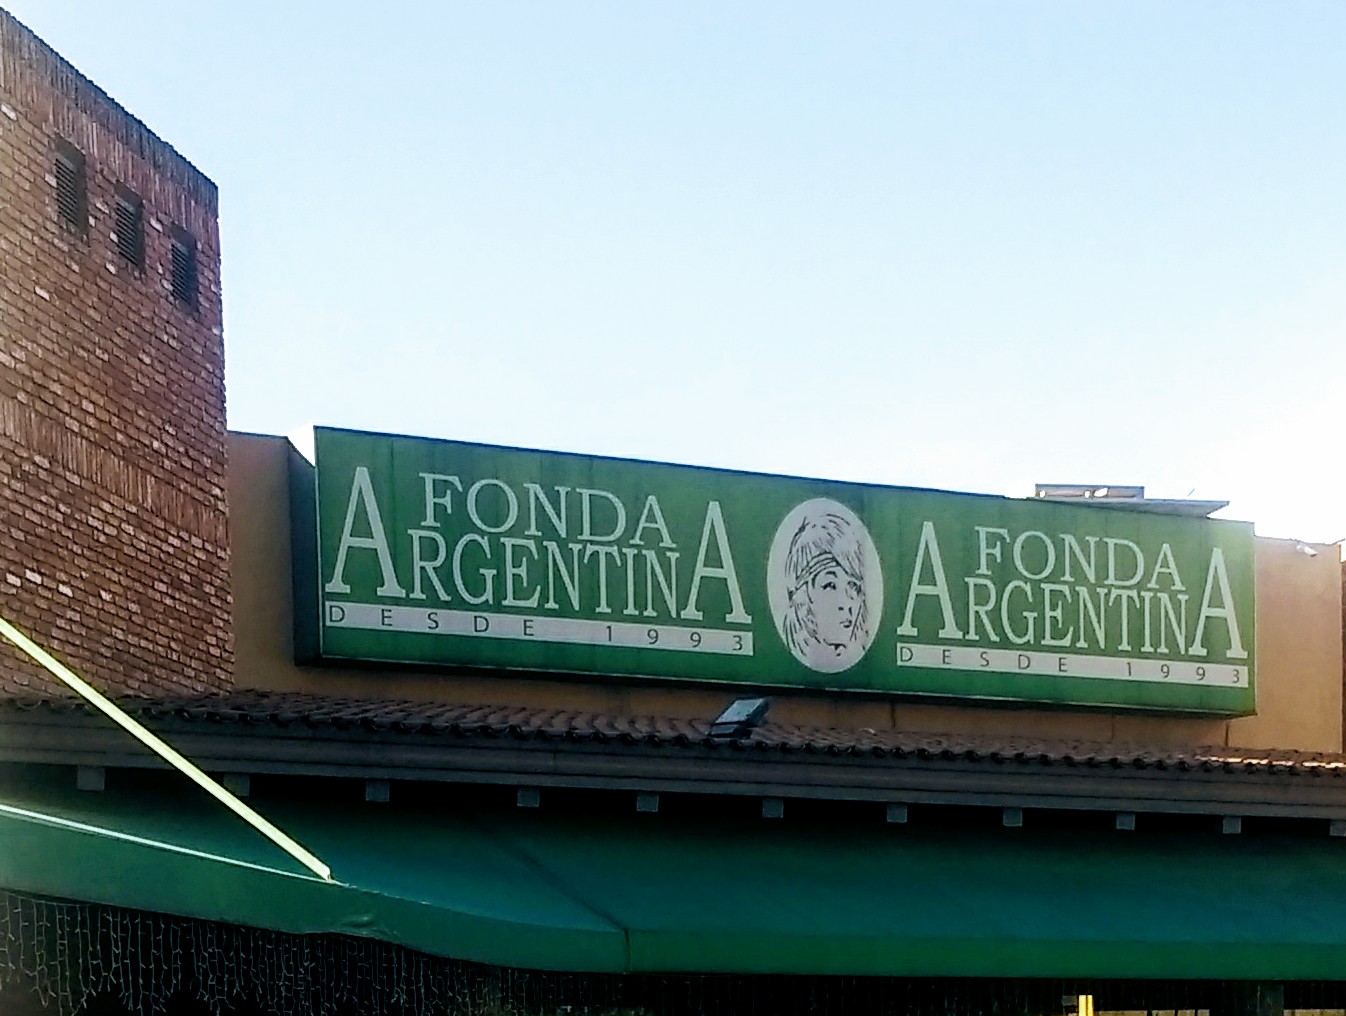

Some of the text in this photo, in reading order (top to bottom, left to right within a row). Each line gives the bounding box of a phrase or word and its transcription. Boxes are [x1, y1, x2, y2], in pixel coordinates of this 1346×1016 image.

[325, 466, 753, 624] ARGENTINA
[418, 472, 677, 548] FONDA
[897, 521, 1248, 659] ARGENTINA
[974, 525, 1186, 592] FONDA
[329, 604, 744, 652] DESDE 1993
[899, 645, 1241, 684] DESDE 1993
